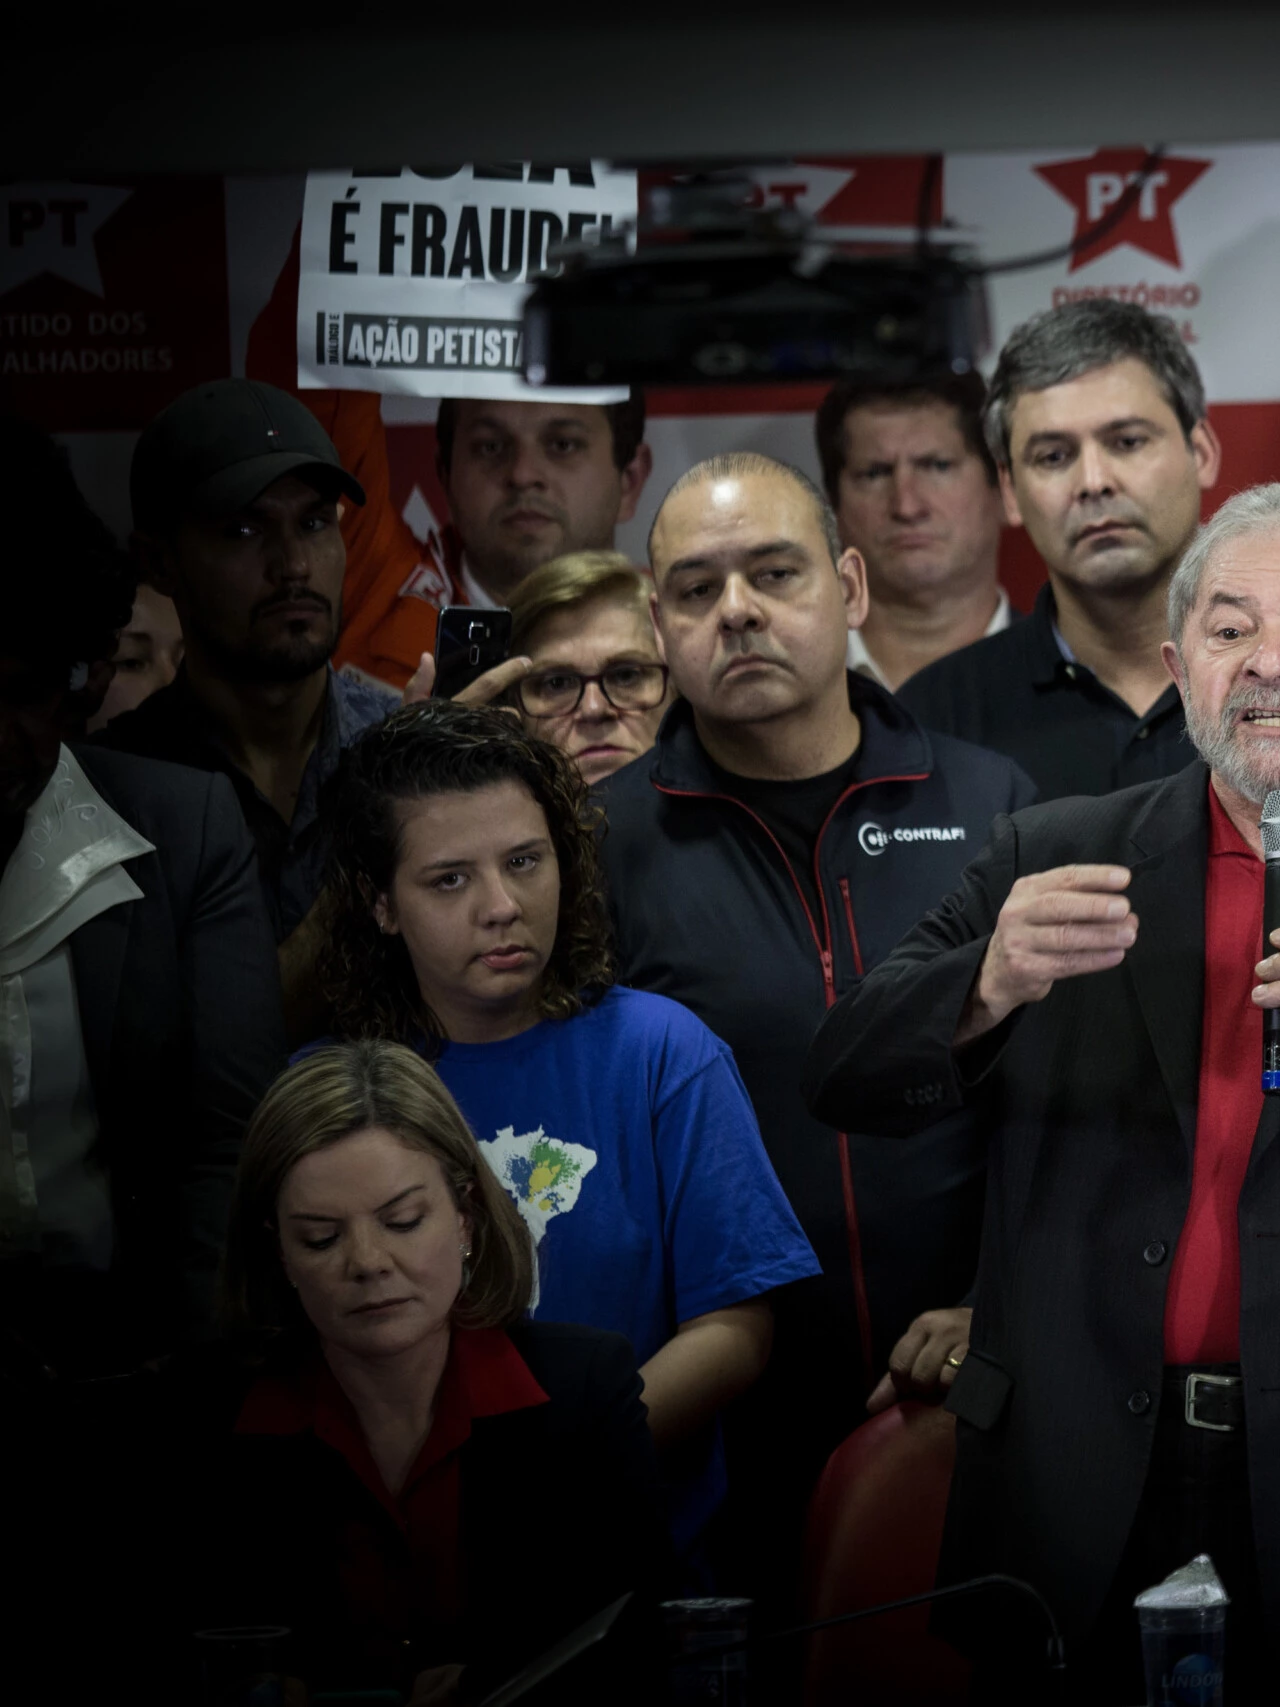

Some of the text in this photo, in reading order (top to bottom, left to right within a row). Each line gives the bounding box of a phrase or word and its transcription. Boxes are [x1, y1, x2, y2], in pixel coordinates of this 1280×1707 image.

[1086, 171, 1170, 223] PT
[8, 200, 89, 247] PT
[329, 186, 361, 274] É
[0, 309, 148, 338] TIDO DOS
[347, 317, 420, 368] AÇÃO
